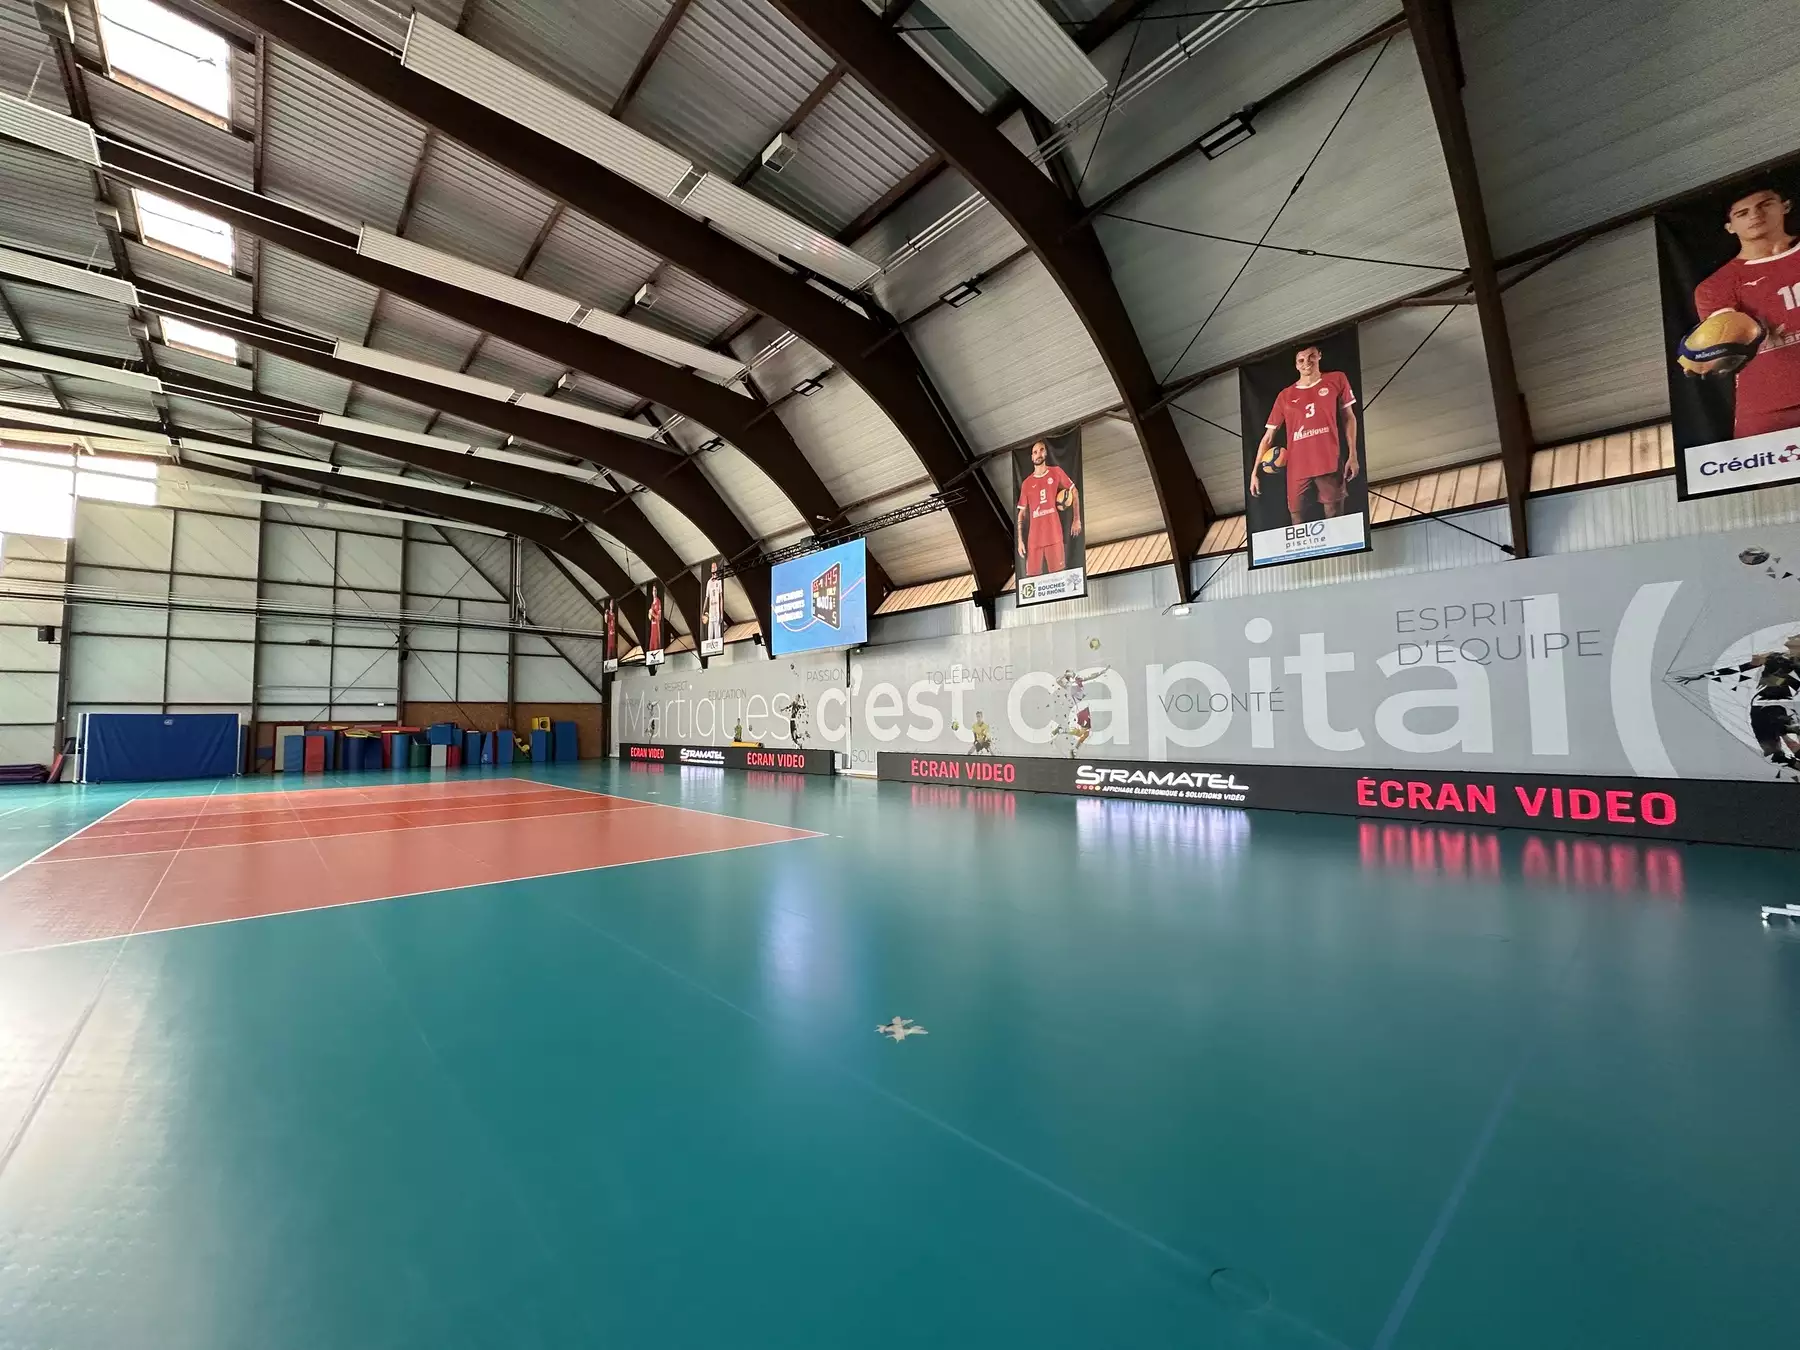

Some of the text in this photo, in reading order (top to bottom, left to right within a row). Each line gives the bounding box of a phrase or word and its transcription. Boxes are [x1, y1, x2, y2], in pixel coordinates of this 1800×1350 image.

[1305, 402, 1316, 418] 3
[1700, 451, 1776, 477] Crédit
[1285, 535, 1326, 549] piscine
[1037, 581, 1066, 592] BOUCHES
[1396, 598, 1535, 634] ESPRIT
[1397, 628, 1602, 668] D'ÉQUIPE
[806, 667, 848, 683] PASSION
[925, 664, 1014, 685] TOLÉRANCE
[816, 663, 976, 744] c'est
[1158, 685, 1286, 714] VOLONTÉ
[680, 748, 725, 759] STRAMATEL
[777, 753, 805, 768] VIDEO
[911, 757, 1016, 783] ÉCRAN VIDEO
[1075, 765, 1249, 791] STRAMATEL
[1102, 785, 1134, 794] AFFICHAGE
[1185, 790, 1223, 800] SOLUTIONS
[1356, 777, 1678, 825] ÉCRAN VIDEO
